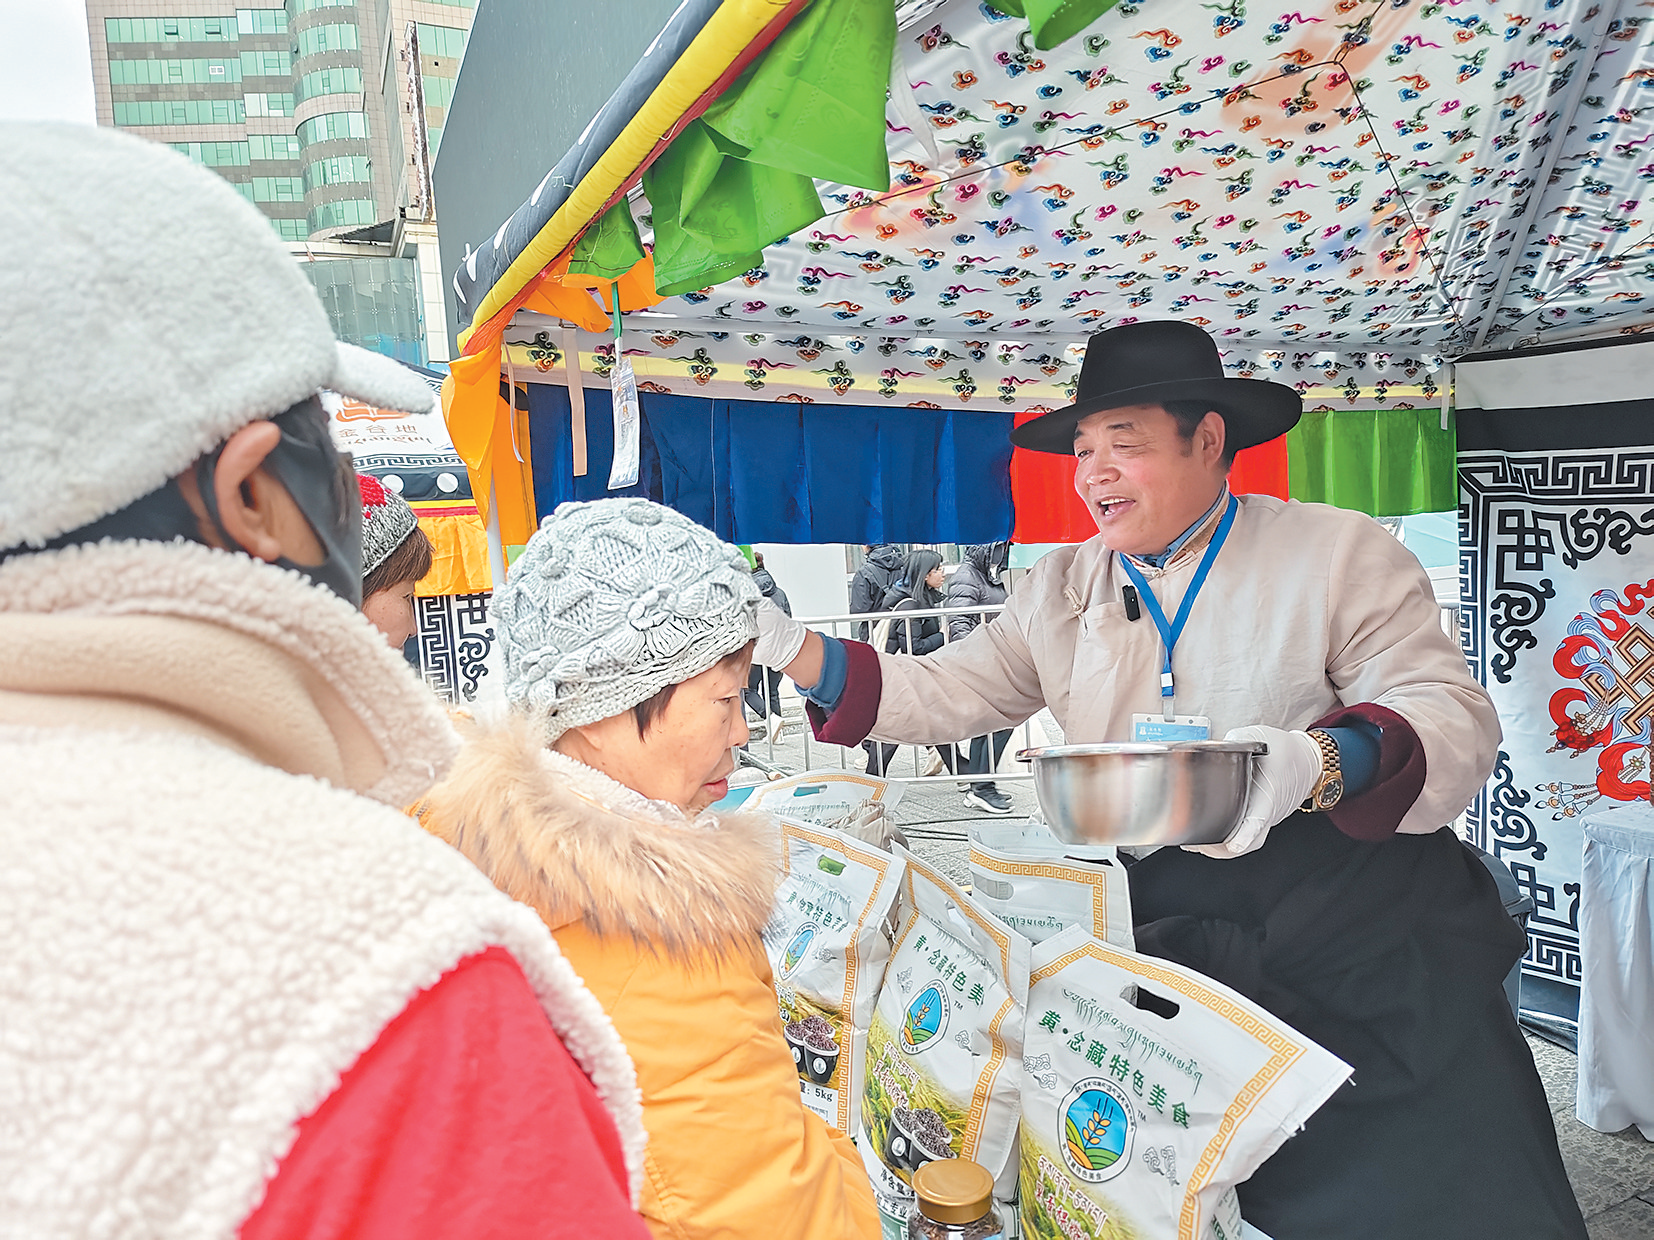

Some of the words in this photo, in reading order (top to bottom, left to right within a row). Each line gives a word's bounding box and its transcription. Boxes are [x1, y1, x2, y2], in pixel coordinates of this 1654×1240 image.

[1038, 1010, 1190, 1129] 黄·念藏特色美食
[815, 1087, 833, 1102] 5kg
[1137, 1109, 1147, 1122] TM
